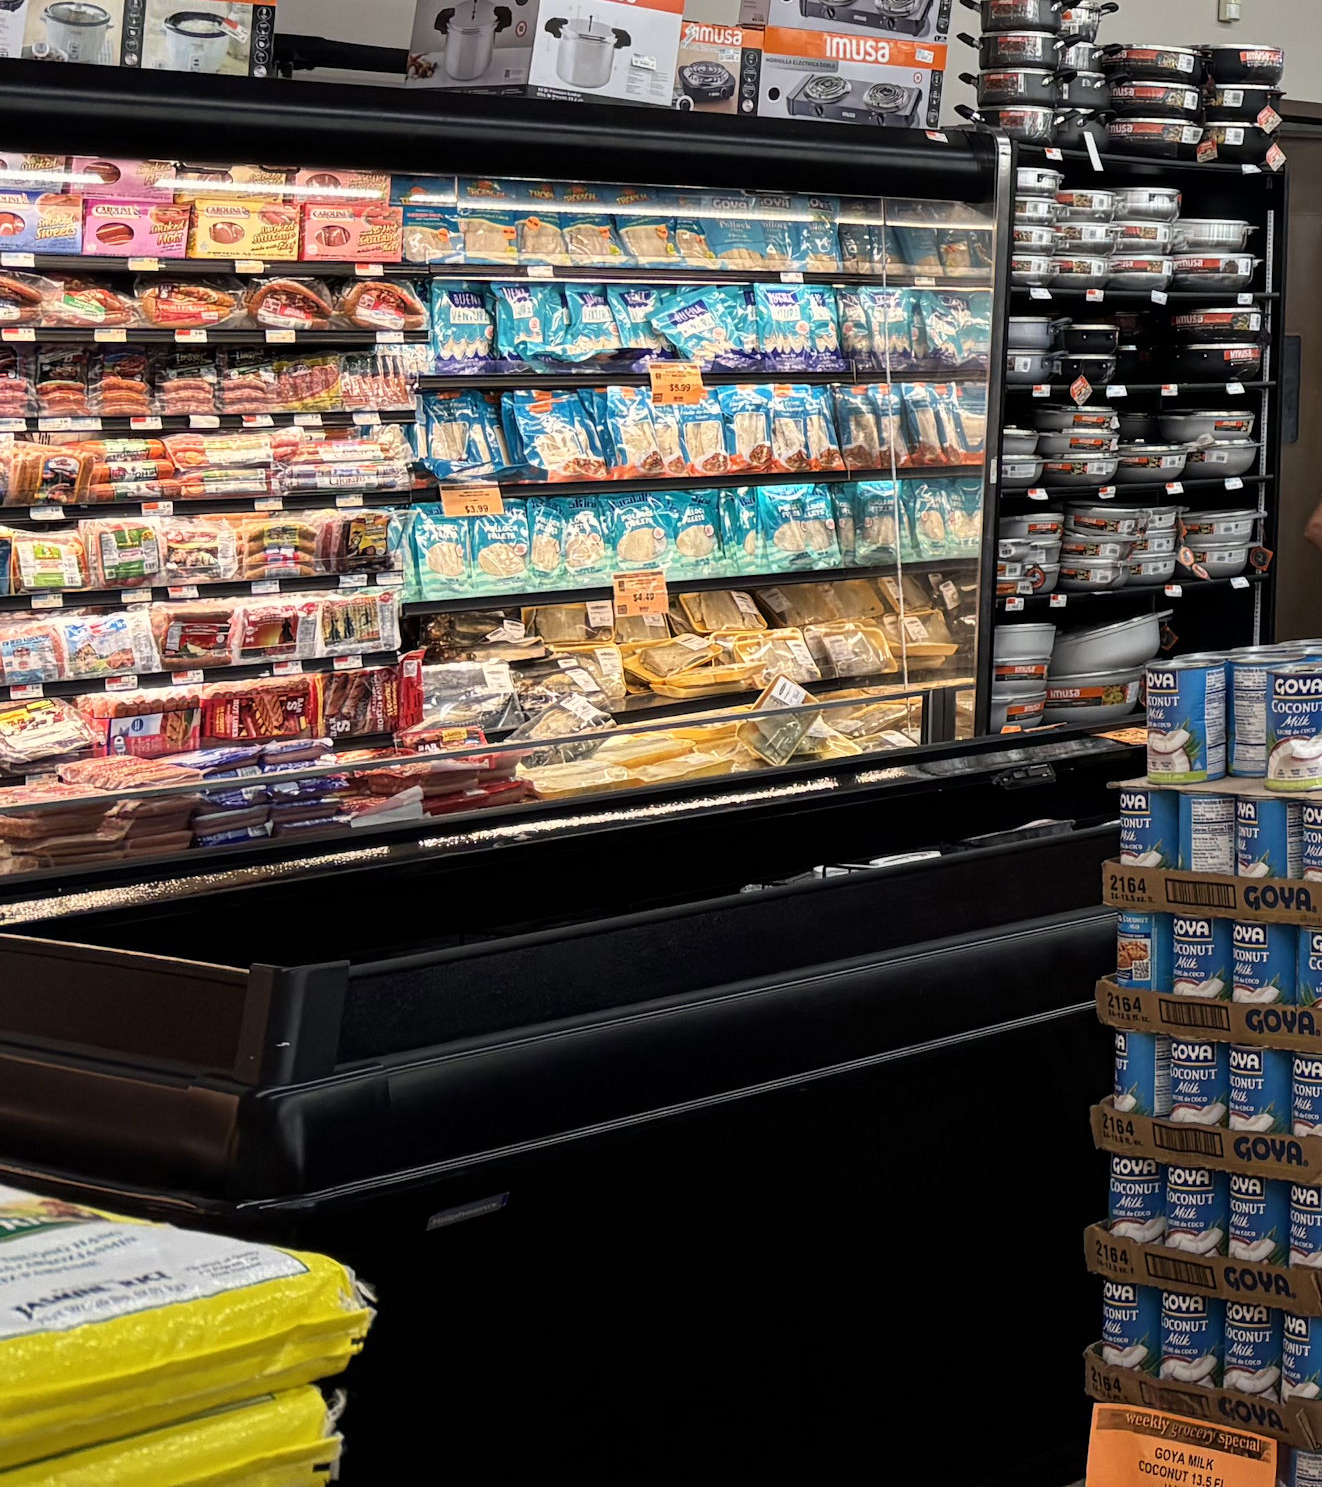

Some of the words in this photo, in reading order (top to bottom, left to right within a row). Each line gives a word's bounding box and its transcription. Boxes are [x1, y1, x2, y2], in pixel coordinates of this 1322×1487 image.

[1148, 672, 1175, 689] OYA
[1280, 714, 1311, 728] Milk
[1110, 873, 1148, 894] 2164
[1243, 885, 1312, 913] GOYA
[1106, 991, 1143, 1014] 2164
[1245, 1007, 1316, 1037] GOYA
[1171, 1041, 1214, 1060] GOYA
[1102, 1113, 1136, 1137] 2164
[1233, 1136, 1304, 1165] GOYA
[1112, 1156, 1157, 1176] GOYA
[1167, 1166, 1211, 1185] GOYA
[1110, 1180, 1161, 1196] COCONUT
[1095, 1240, 1130, 1264] 2164
[1224, 1266, 1292, 1296] GOYA
[1163, 1294, 1204, 1312] GOYA
[1226, 1303, 1268, 1322] GOYA
[1218, 1397, 1286, 1432] GOYA
[1126, 1411, 1170, 1435] weekly
[1170, 1422, 1217, 1444] grocery
[1218, 1432, 1262, 1454] special
[1154, 1447, 1186, 1465] GOYA
[1188, 1454, 1214, 1471] MILK
[1138, 1460, 1188, 1483] COCONUT
